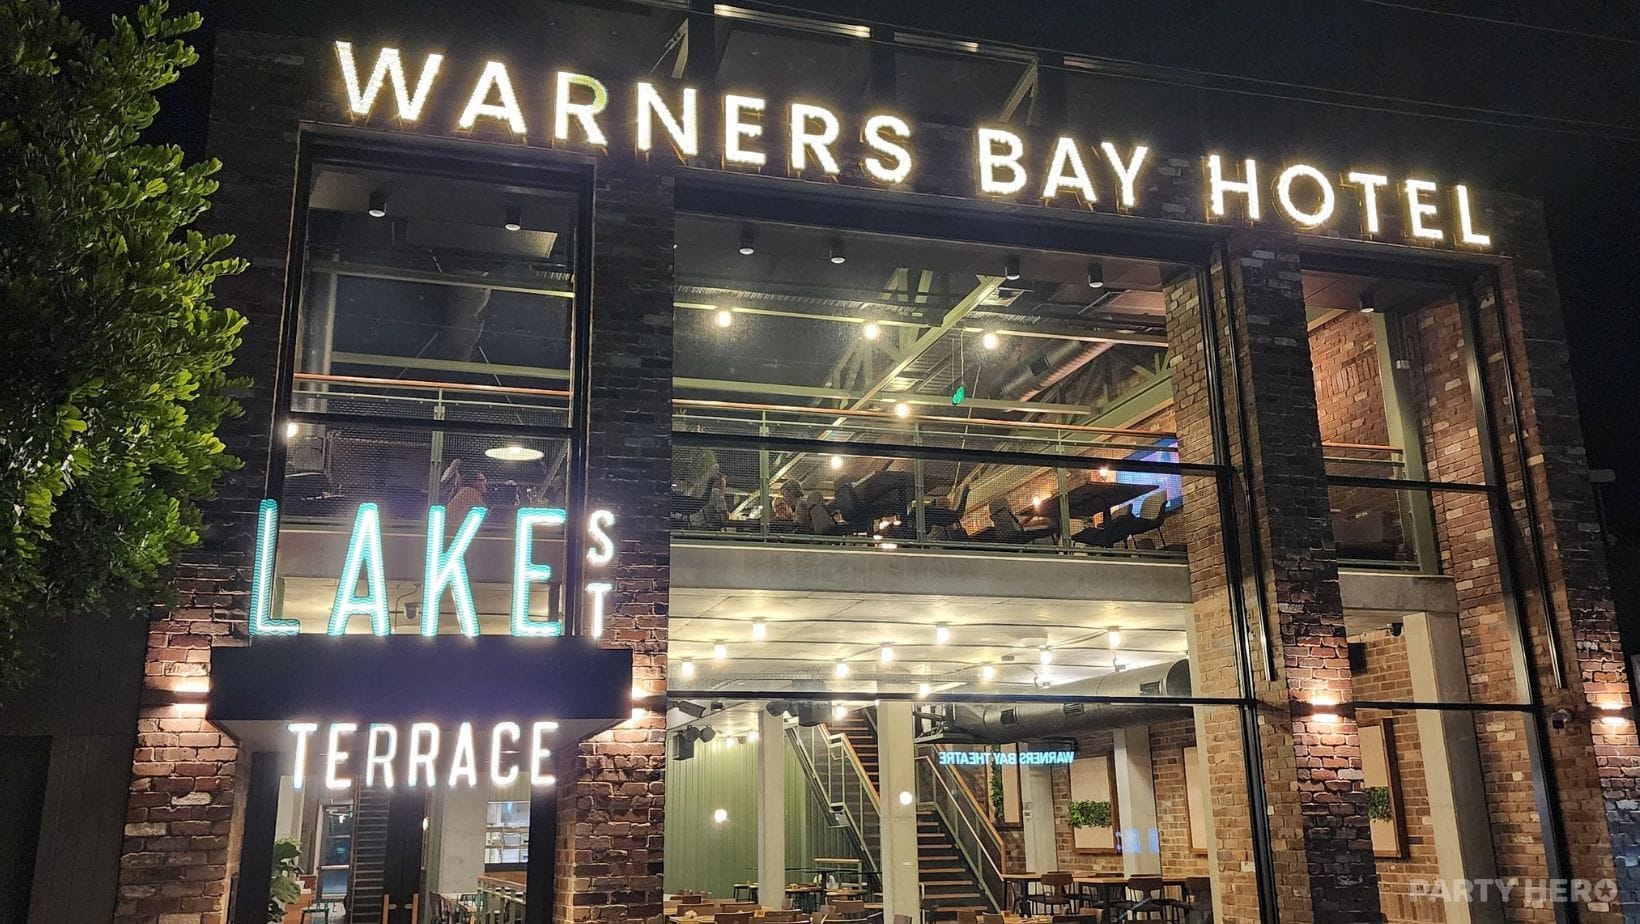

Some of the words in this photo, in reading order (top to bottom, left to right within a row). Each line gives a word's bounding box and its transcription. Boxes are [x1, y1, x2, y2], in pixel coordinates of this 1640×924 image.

[333, 39, 915, 184] WARNERS
[976, 126, 1149, 208] BAY
[1207, 153, 1491, 247] HOTEL
[248, 498, 567, 638] LAKE
[287, 721, 560, 790] TERRACE
